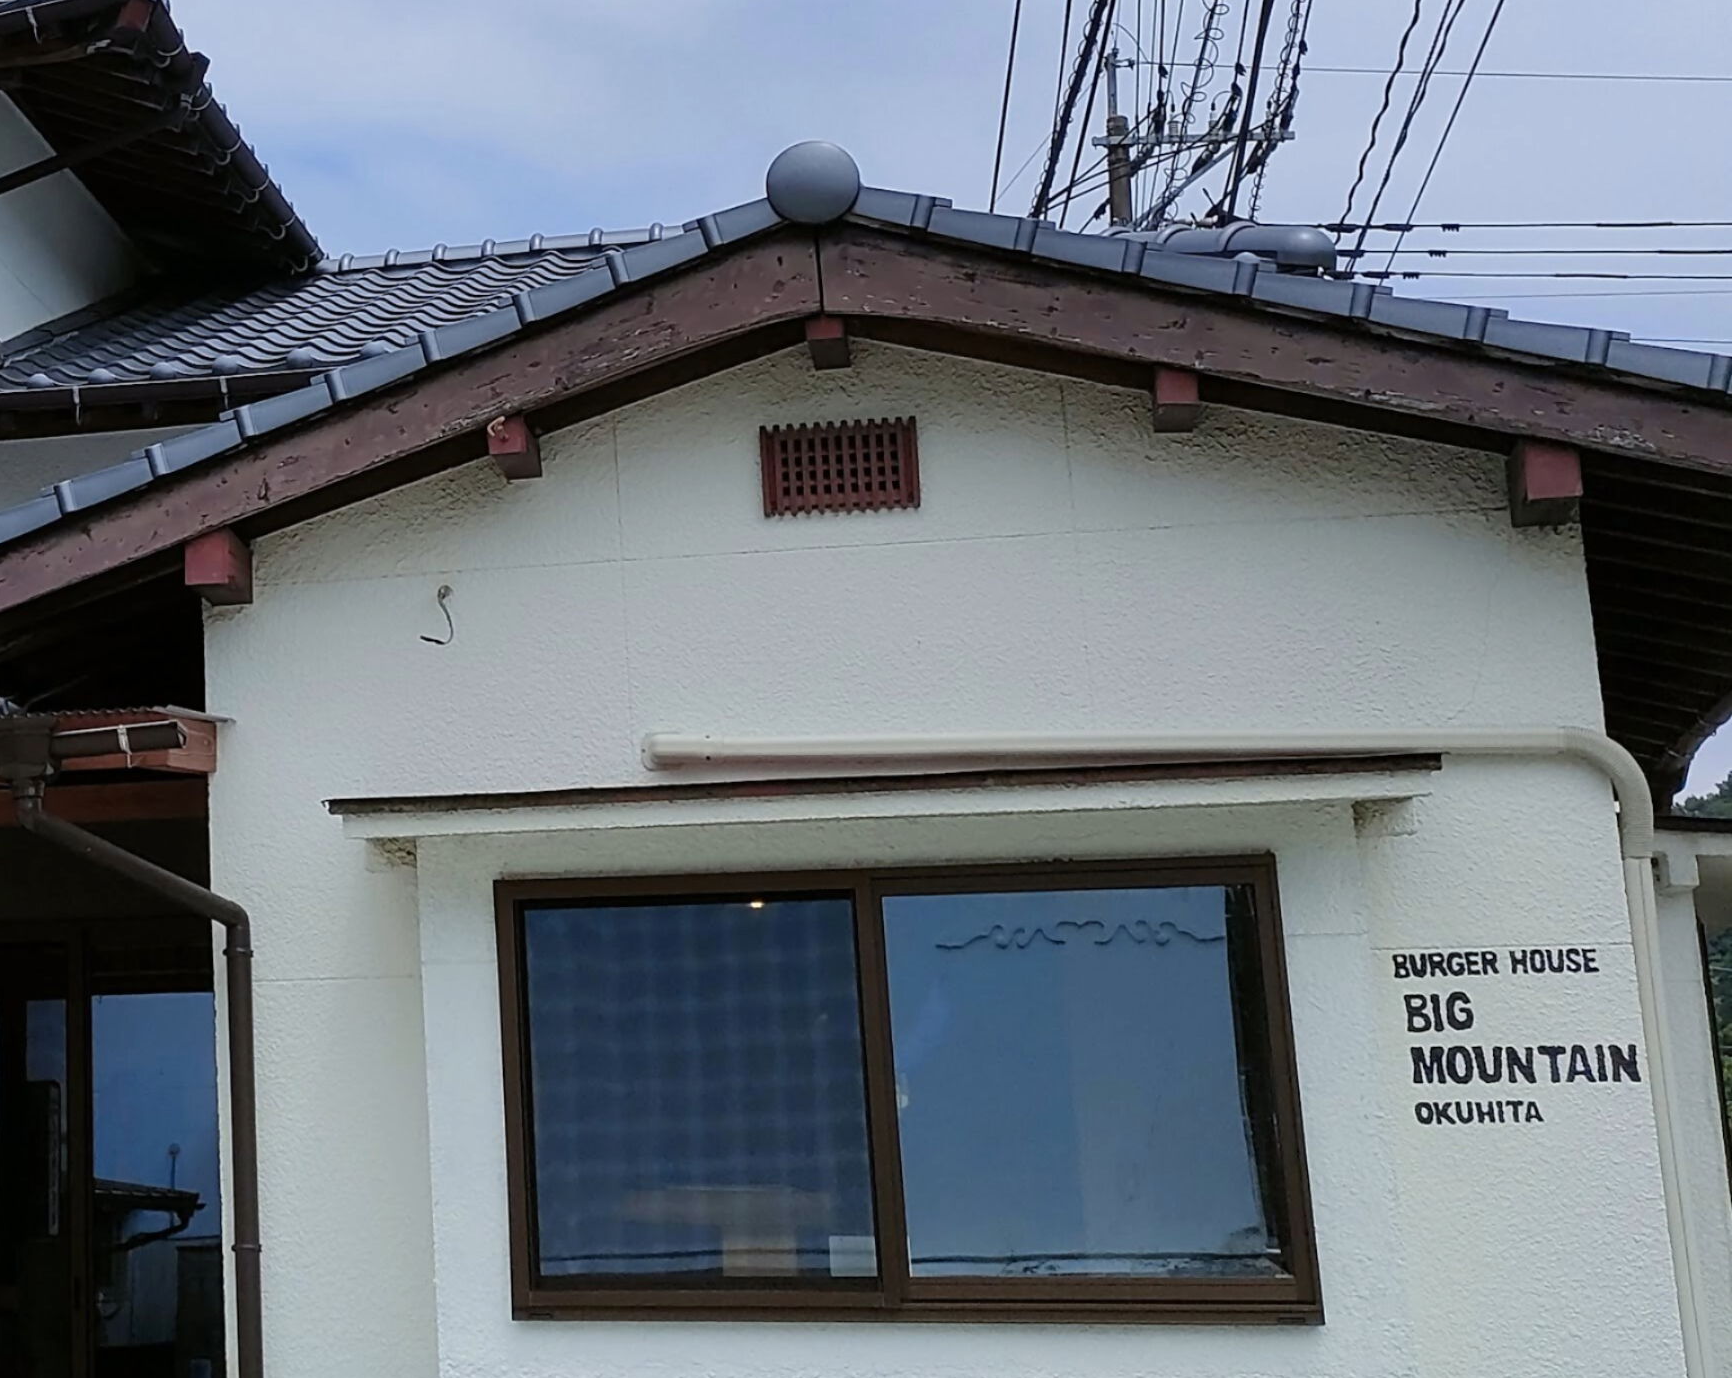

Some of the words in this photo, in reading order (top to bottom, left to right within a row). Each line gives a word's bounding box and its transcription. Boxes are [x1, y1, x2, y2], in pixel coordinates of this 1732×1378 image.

[1392, 950, 1499, 979] BURGER
[1509, 948, 1599, 974] HOUSE
[1404, 992, 1474, 1033] BIG
[1410, 1044, 1641, 1084] MOUNTAIN
[1414, 1100, 1544, 1124] OKUHITA
